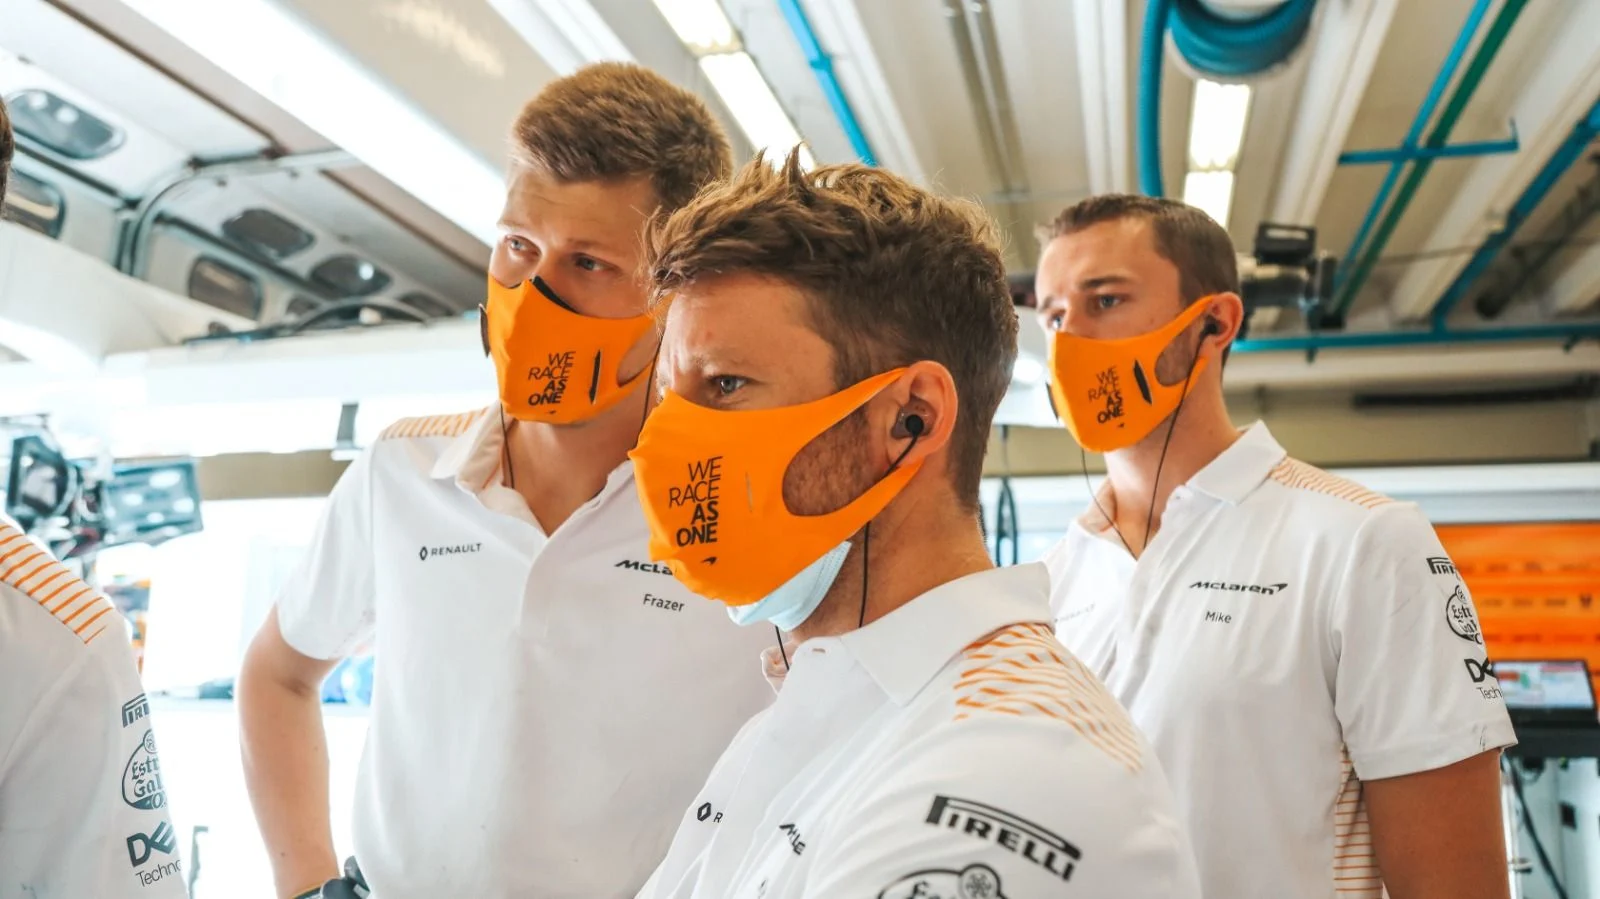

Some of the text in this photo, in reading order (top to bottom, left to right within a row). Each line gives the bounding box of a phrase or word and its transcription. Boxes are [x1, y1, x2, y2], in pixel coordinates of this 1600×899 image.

[548, 351, 576, 367] WE
[528, 366, 570, 380] RACE
[543, 379, 568, 394] AS
[528, 392, 562, 406] ONE
[688, 456, 723, 482] WE
[669, 478, 721, 509] RACE
[691, 500, 719, 525] AS
[676, 522, 718, 547] ONE
[431, 542, 482, 556] RENAULT
[614, 560, 673, 576] McLa
[1189, 581, 1275, 595] McLaren
[643, 594, 685, 612] Frazer
[1205, 611, 1232, 624] Mike
[132, 755, 160, 780] Estr
[924, 795, 1082, 882] PIRELLI
[135, 859, 181, 887] Techno
